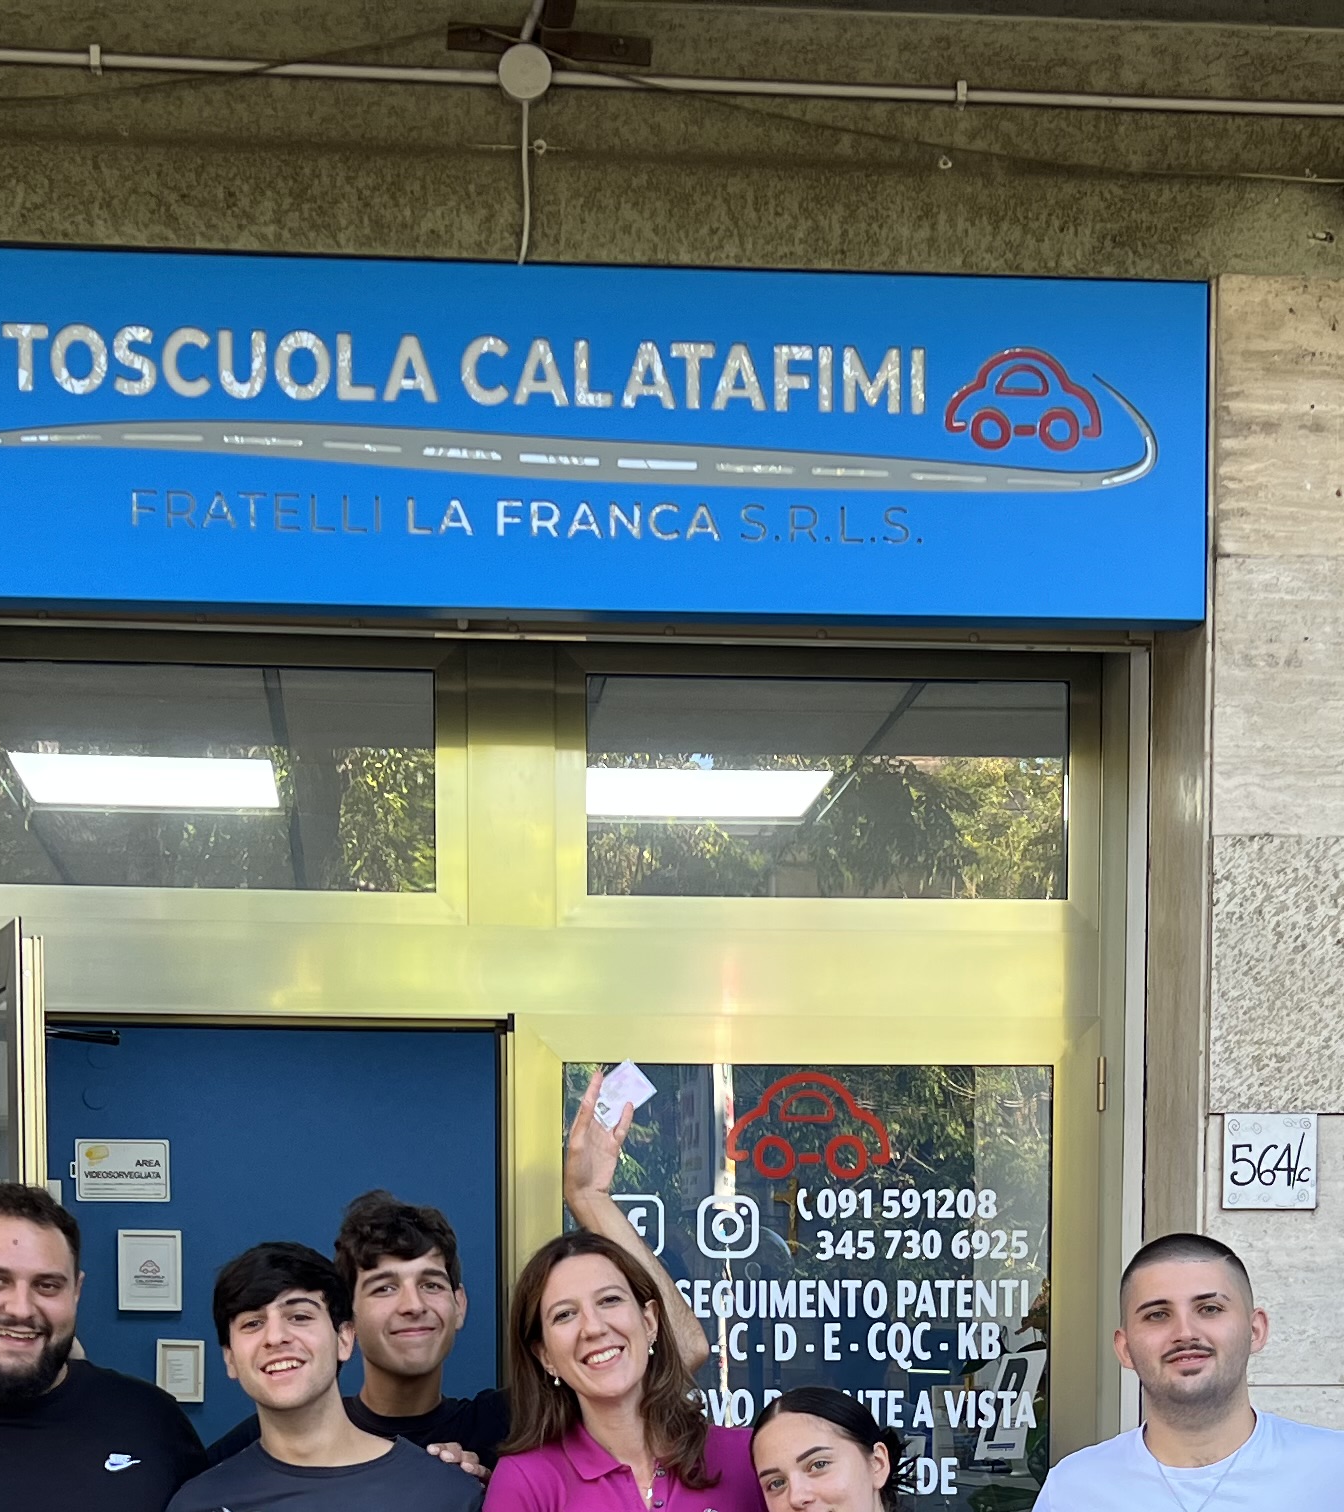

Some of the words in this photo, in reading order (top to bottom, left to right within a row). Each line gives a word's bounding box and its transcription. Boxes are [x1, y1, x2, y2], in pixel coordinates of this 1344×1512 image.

[460, 335, 926, 415] CALATAFIMI
[129, 489, 383, 534] FRATELLI
[406, 497, 475, 537] LA
[496, 500, 722, 541] FRANCA
[739, 503, 923, 545] S.R.L.S.
[134, 1159, 162, 1168] AREA
[816, 1188, 873, 1219] 091
[881, 1188, 998, 1219] 591208
[815, 1229, 876, 1261] 345
[883, 1229, 943, 1261] 730
[951, 1229, 1029, 1261] 6925
[675, 1279, 888, 1319] SEGUIMENTO
[896, 1279, 1029, 1319] PATENTI
[728, 1322, 749, 1361] C
[774, 1322, 798, 1361] D
[823, 1322, 842, 1361] E
[867, 1321, 932, 1370] CQC
[957, 1321, 1001, 1361] KB
[912, 1390, 935, 1429] A
[943, 1390, 1037, 1429] VISTA
